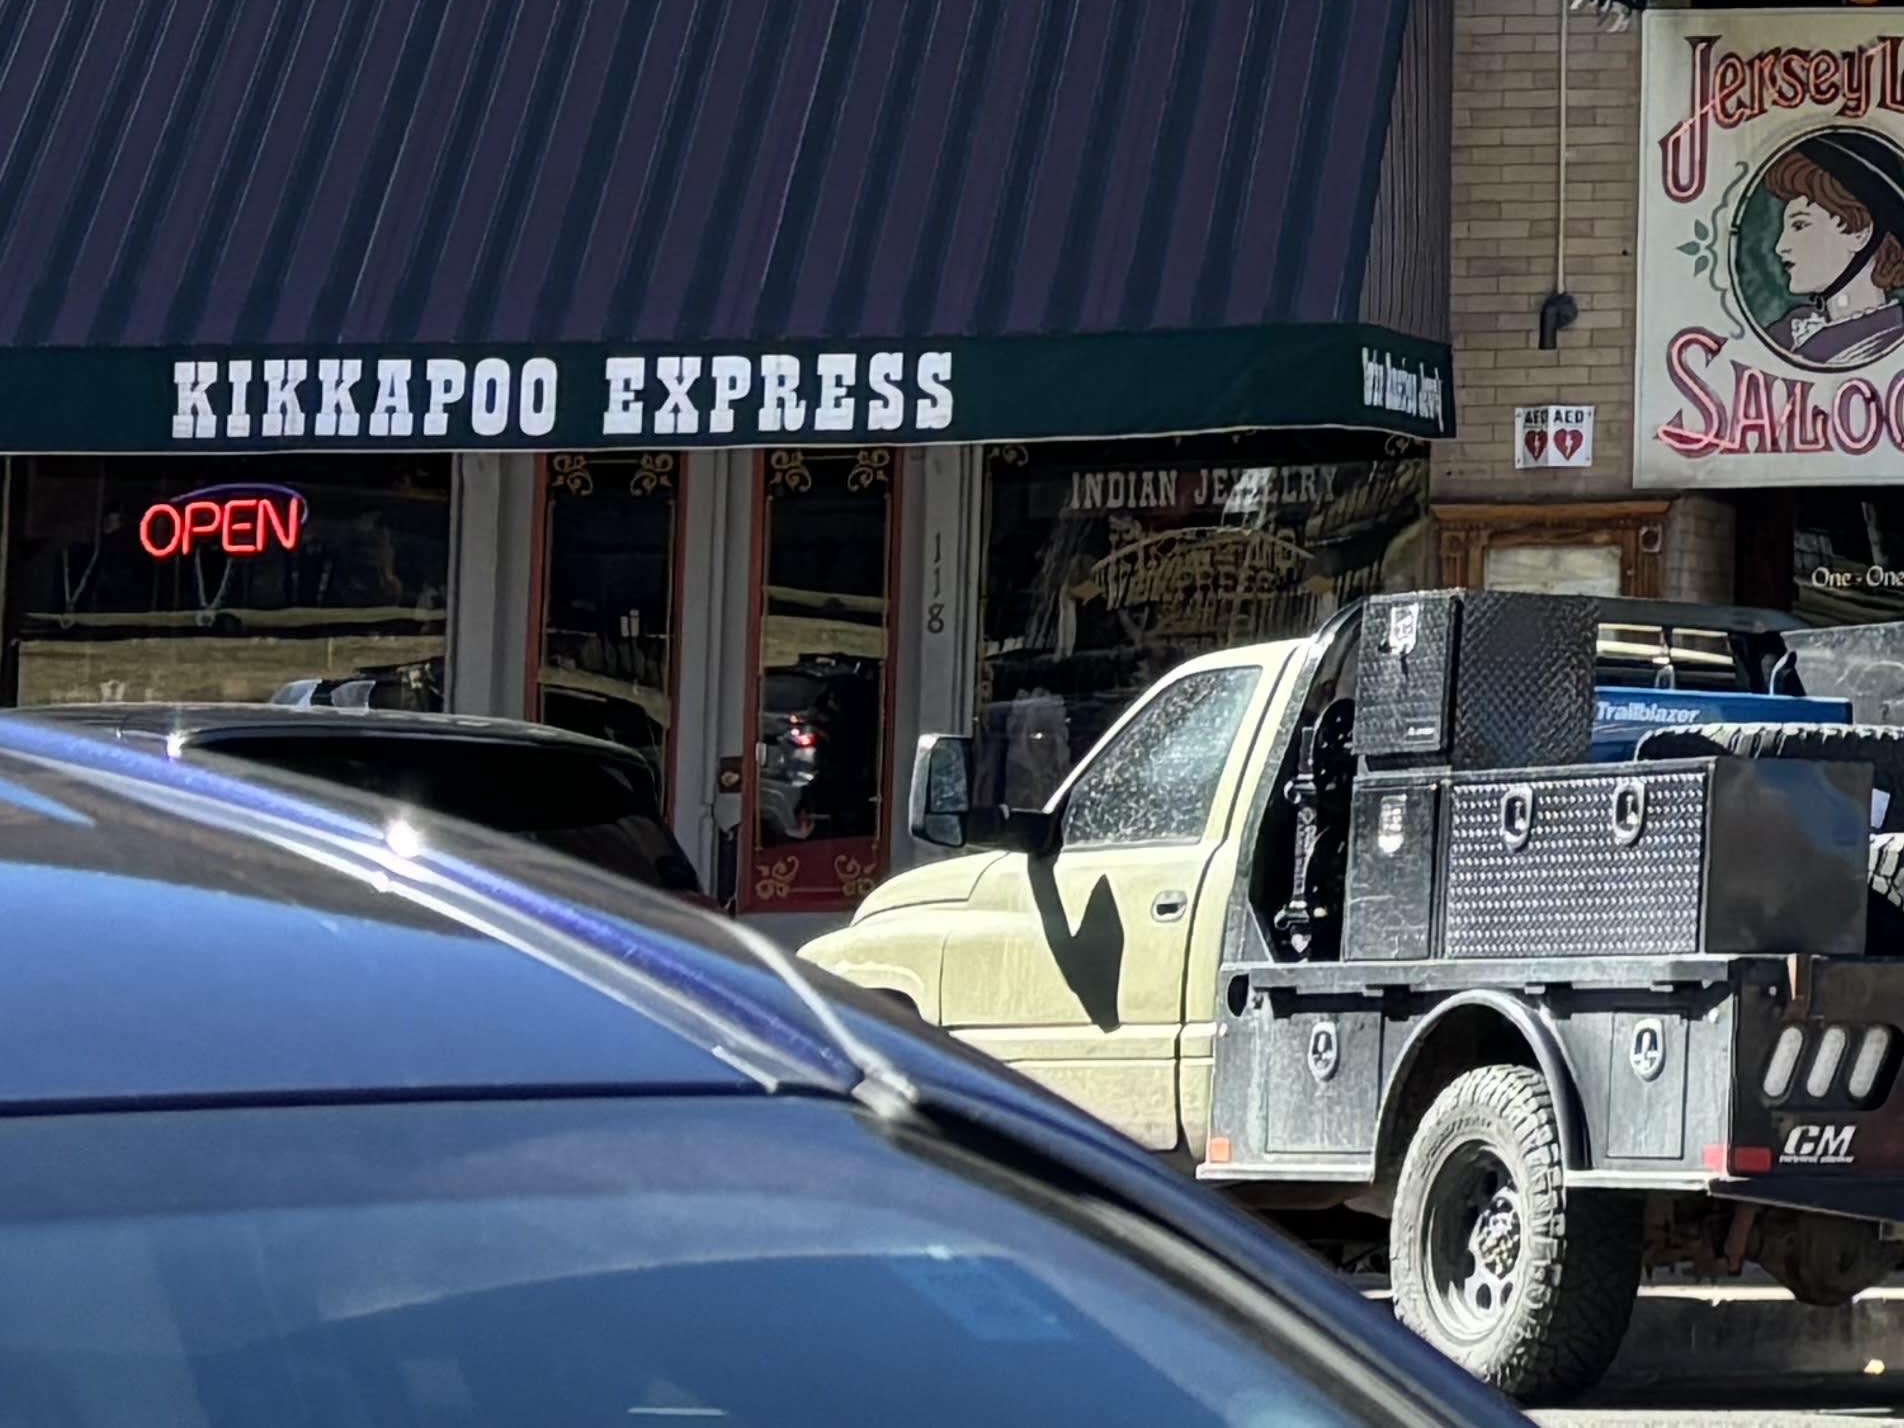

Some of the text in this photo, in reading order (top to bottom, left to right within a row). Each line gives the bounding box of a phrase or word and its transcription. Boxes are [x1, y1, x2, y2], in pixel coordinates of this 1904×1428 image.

[1658, 35, 1880, 204] Jersey
[172, 352, 954, 440] KIKKAPOO EXPRESS
[1553, 409, 1584, 424] AED
[1068, 469, 1178, 510] INDIAN
[140, 497, 302, 559] OPEN
[1811, 566, 1852, 588] One
[1866, 565, 1904, 587] One
[1596, 701, 1700, 725] Trailblazer
